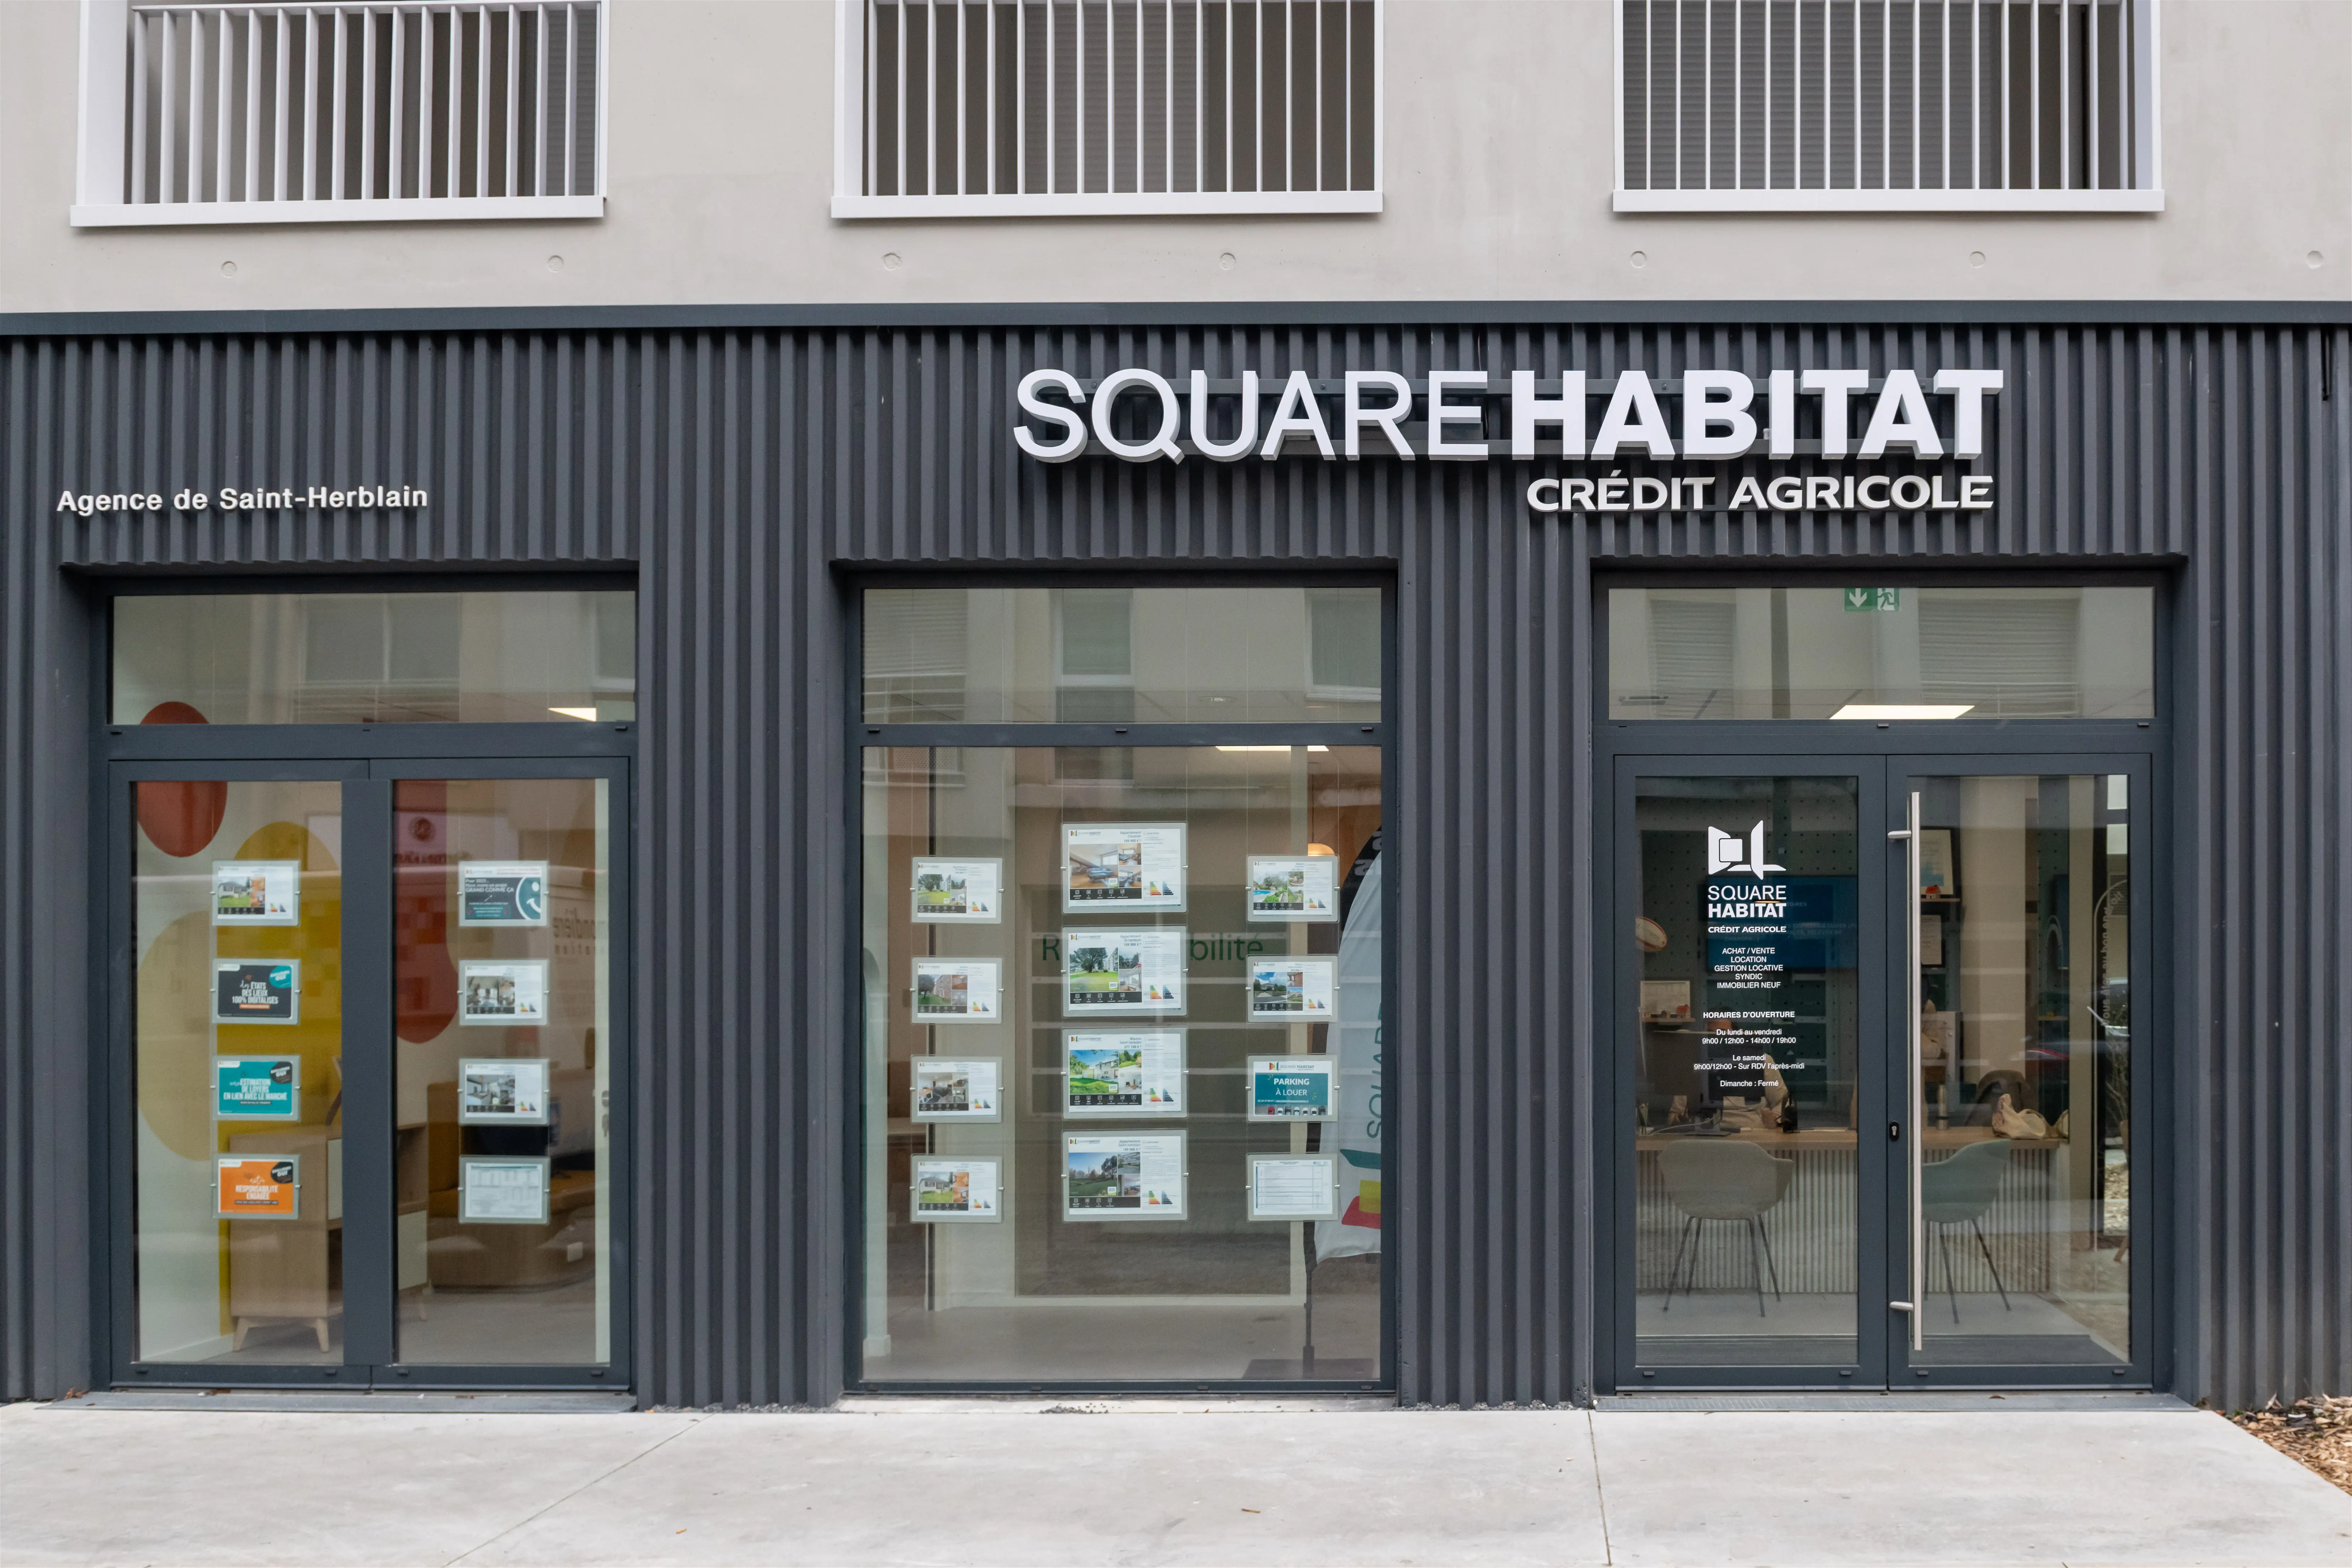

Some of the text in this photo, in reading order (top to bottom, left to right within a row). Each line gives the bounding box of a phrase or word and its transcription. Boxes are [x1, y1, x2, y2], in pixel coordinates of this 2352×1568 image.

[1013, 368, 2004, 465] SQUARE HABITAT
[57, 485, 428, 517] Agence de Saint-Herblain
[1527, 469, 1994, 511] CRÉDIT AGRICOLE
[1708, 885, 1786, 901] SQUARE
[1708, 903, 1786, 918] HABITAT
